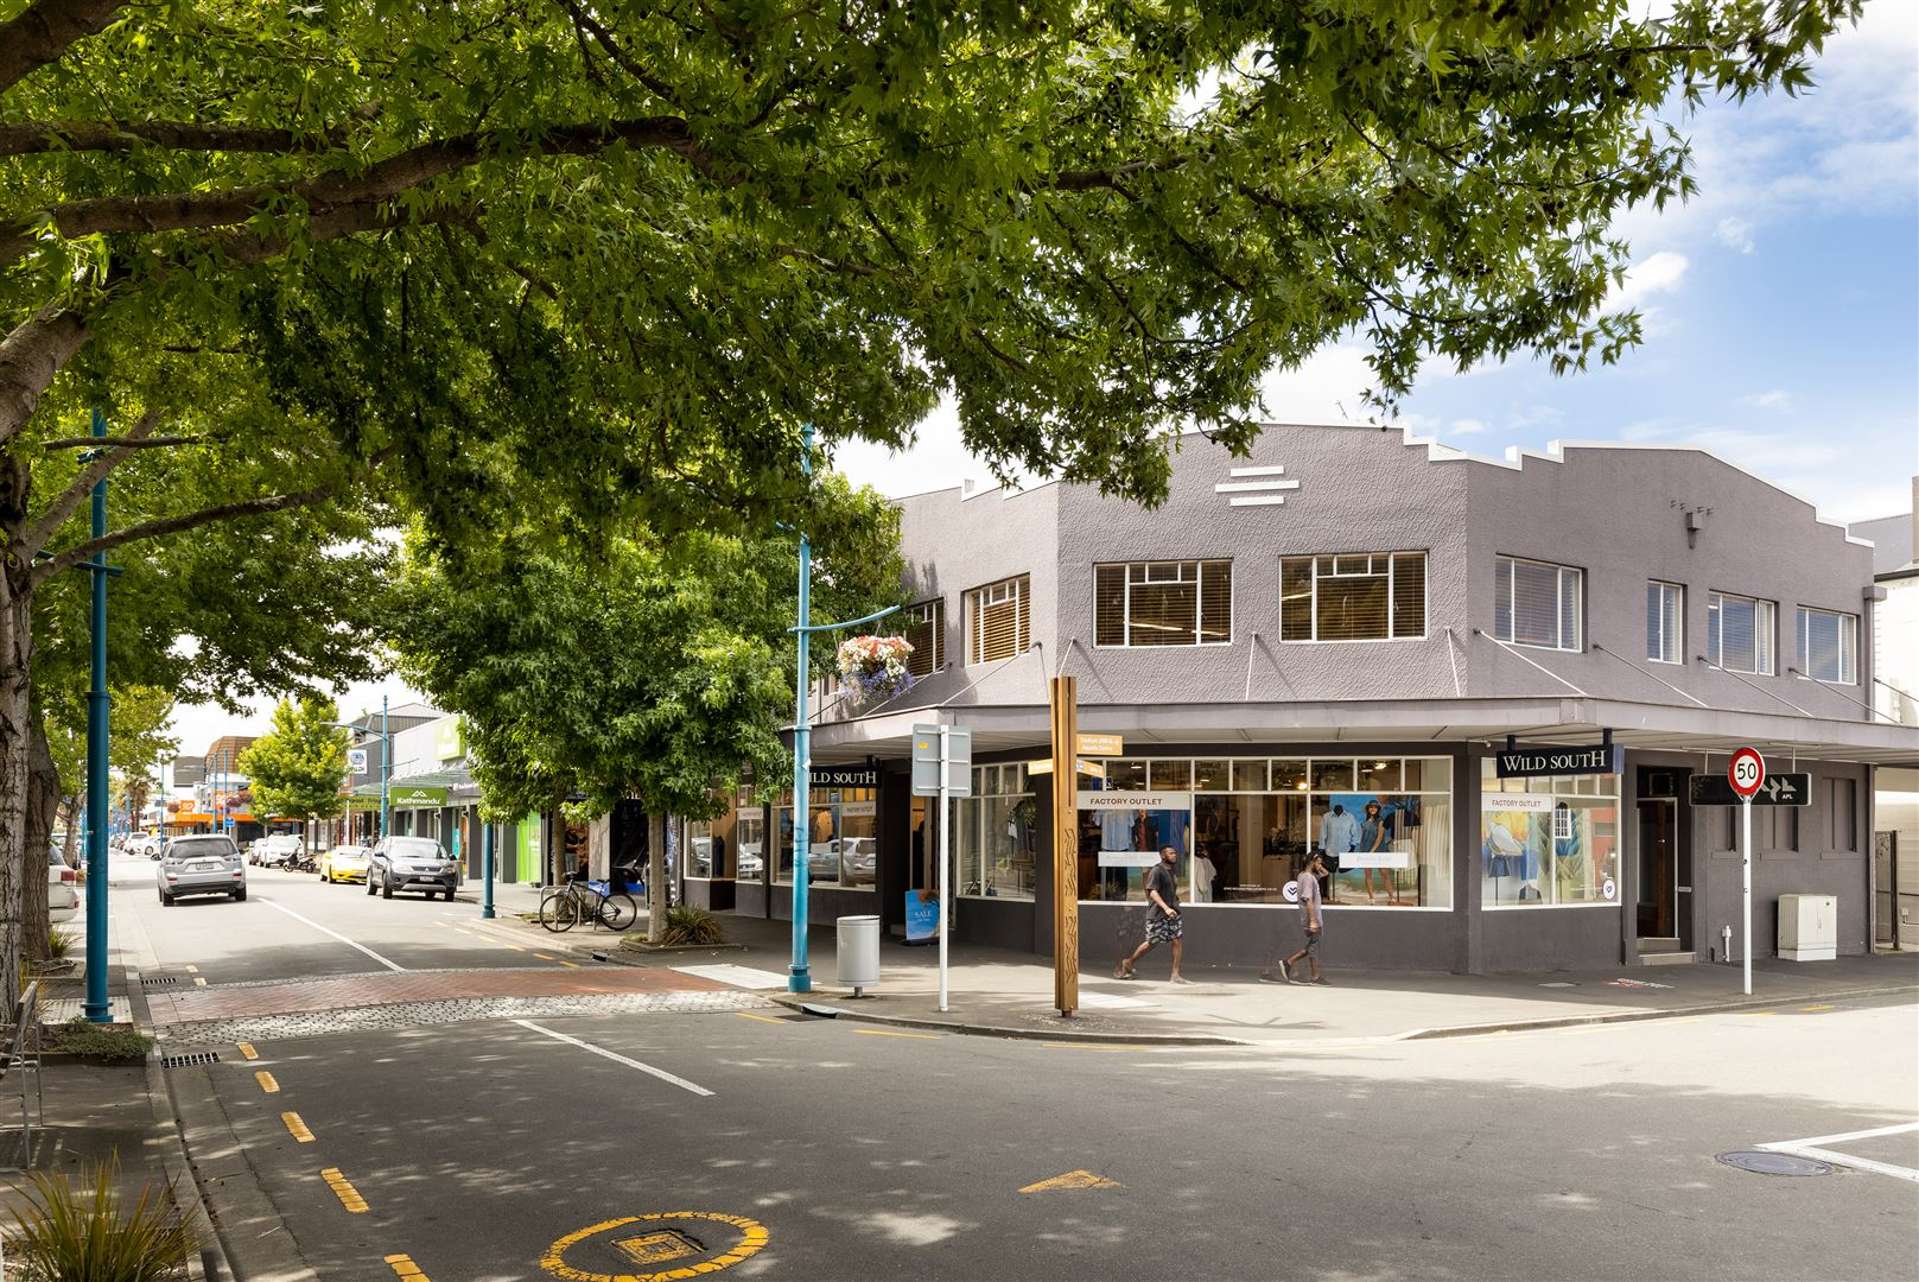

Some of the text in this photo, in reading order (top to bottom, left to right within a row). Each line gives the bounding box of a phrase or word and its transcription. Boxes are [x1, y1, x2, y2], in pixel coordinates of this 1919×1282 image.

[1503, 750, 1606, 772] WILD SOUTH
[808, 771, 877, 784] ILD SOUTH
[1737, 763, 1756, 780] 50
[1491, 799, 1518, 807] FACTORY
